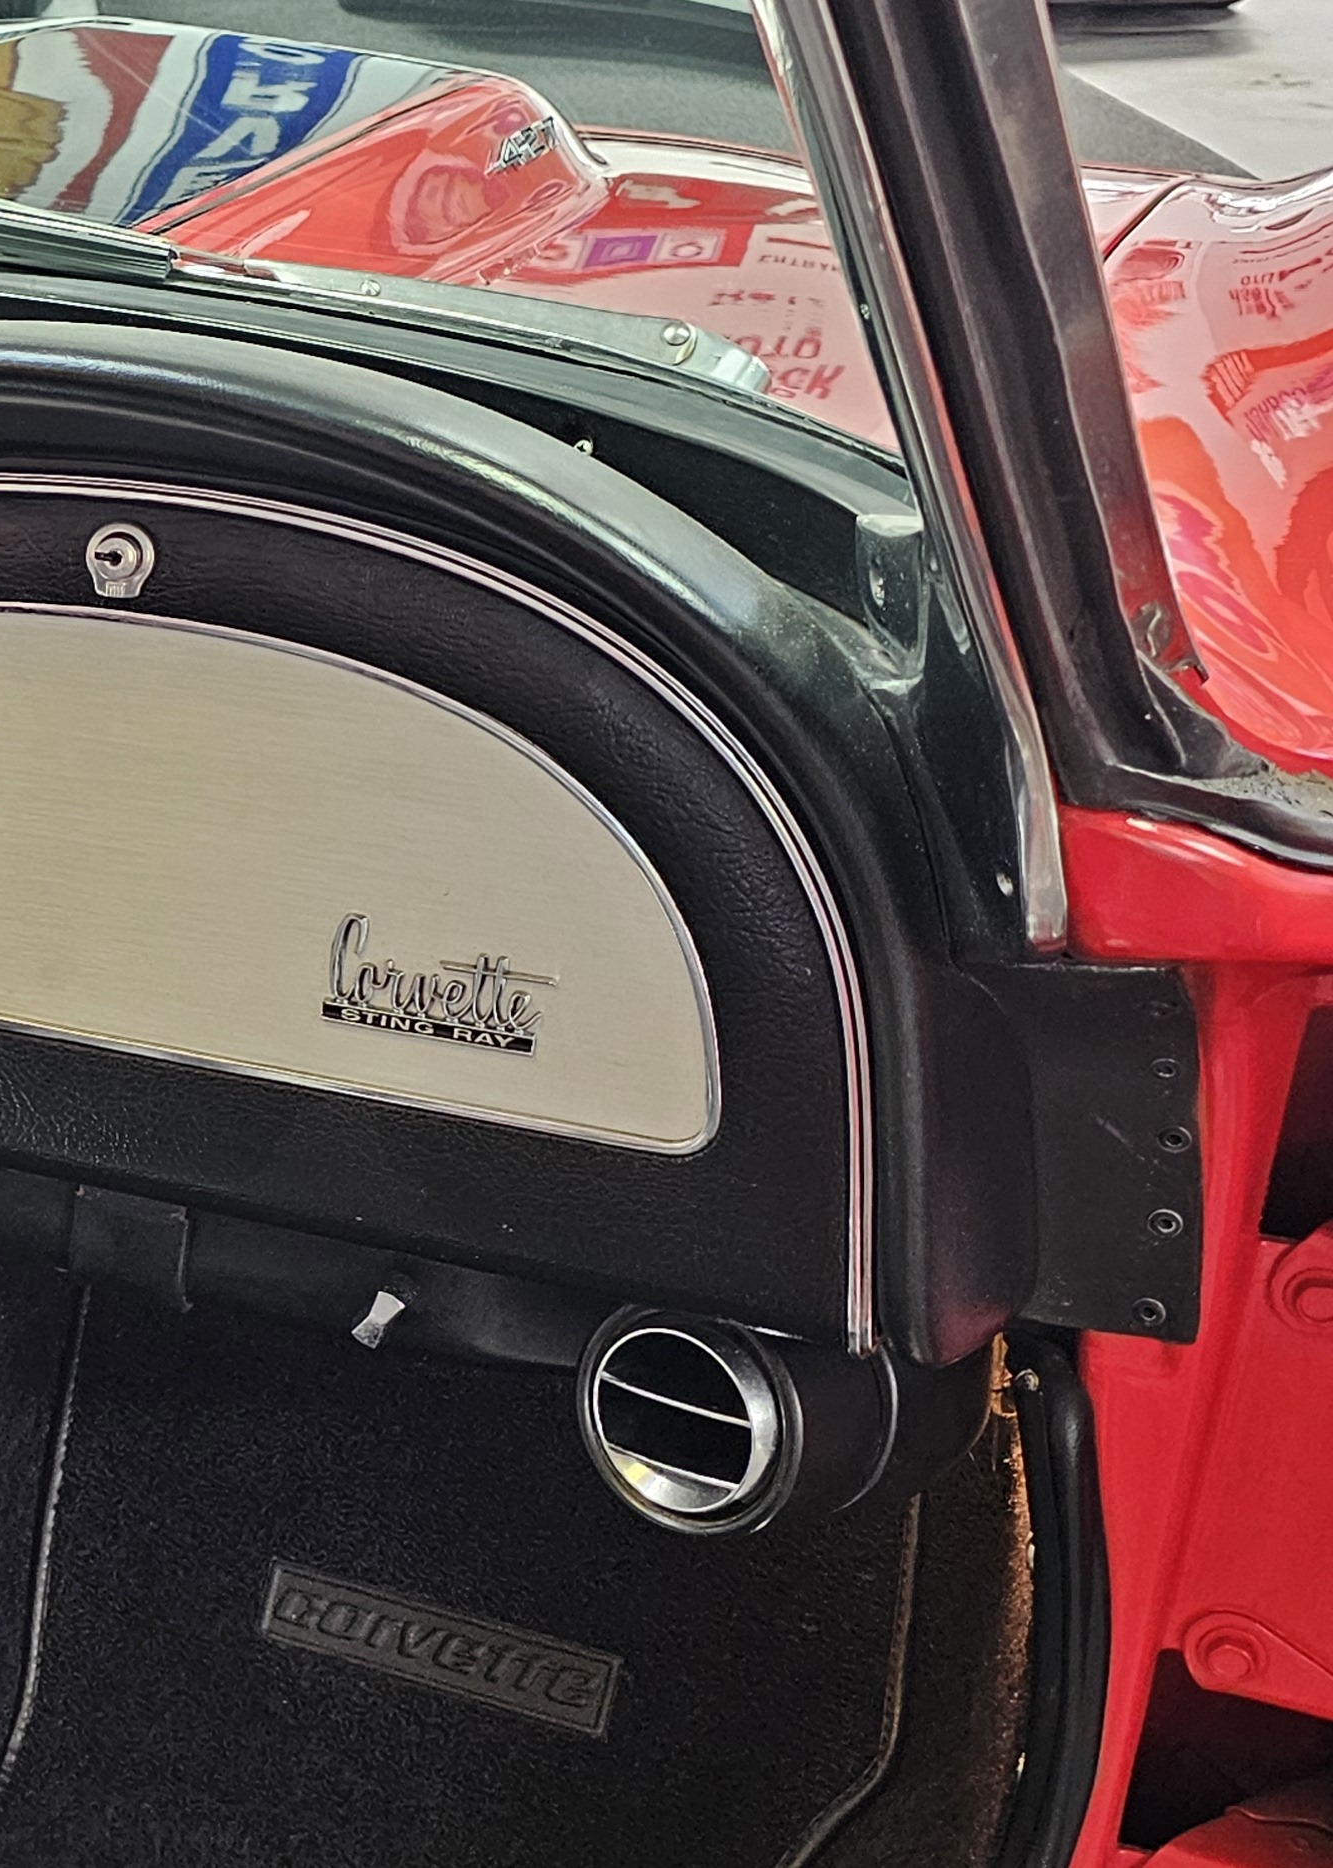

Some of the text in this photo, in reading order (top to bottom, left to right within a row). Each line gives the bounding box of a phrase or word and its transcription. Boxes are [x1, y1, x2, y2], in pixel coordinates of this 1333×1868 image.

[330, 913, 560, 1030] Corvette
[341, 1007, 515, 1048] STING RAY
